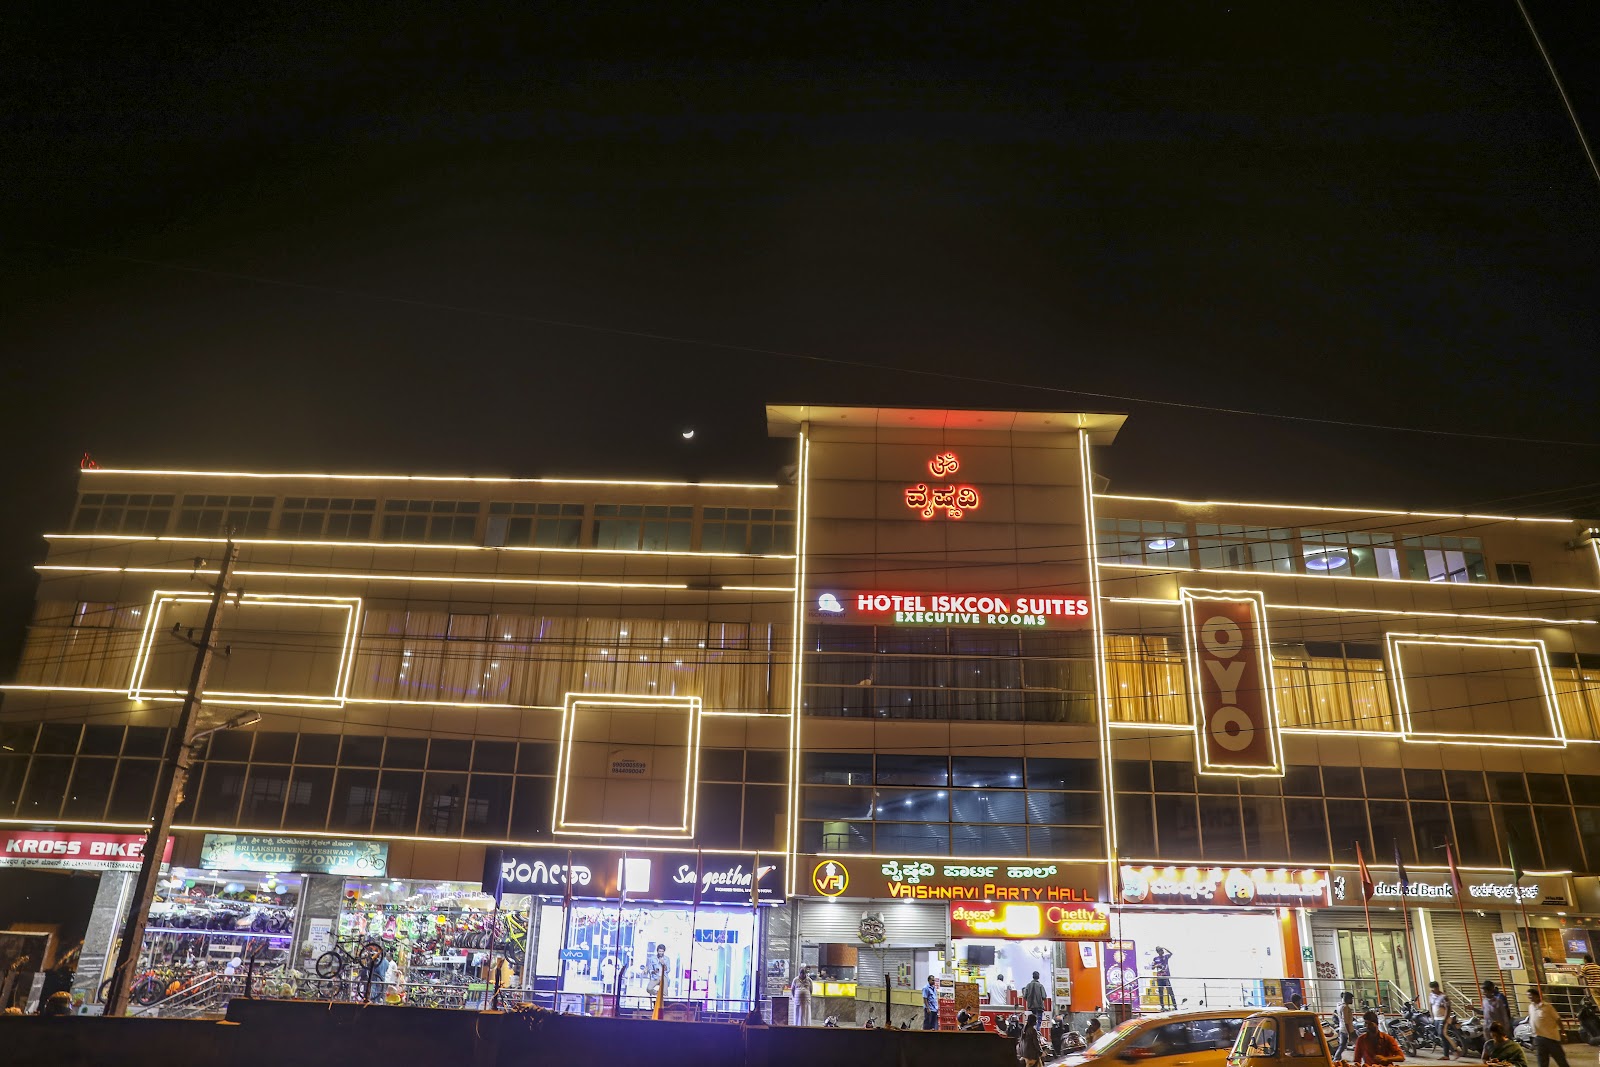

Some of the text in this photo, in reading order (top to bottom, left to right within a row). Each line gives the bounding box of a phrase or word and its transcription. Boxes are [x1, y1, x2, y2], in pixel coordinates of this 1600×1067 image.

[906, 484, 979, 518] ವೈಷ್ಣವಿ
[858, 595, 1088, 615] HOTEL ISKCON SUITES
[896, 612, 1045, 625] EXECUTIVE ROOMS
[1201, 616, 1254, 751] OYO
[5, 838, 81, 855] KROSS
[287, 848, 354, 856] VENKATESHWARA
[238, 852, 349, 865] CYCLE ZONE
[882, 861, 935, 883] ವೈಷ್ಣವಿ
[1007, 865, 1058, 878] ಹಾಲ್
[888, 882, 1094, 901] VAISHNAVI PARTY HALL
[1420, 883, 1453, 898] Bank
[1047, 906, 1106, 923] Chetty's
[1061, 922, 1107, 932] corner
[562, 950, 583, 958] vivo
